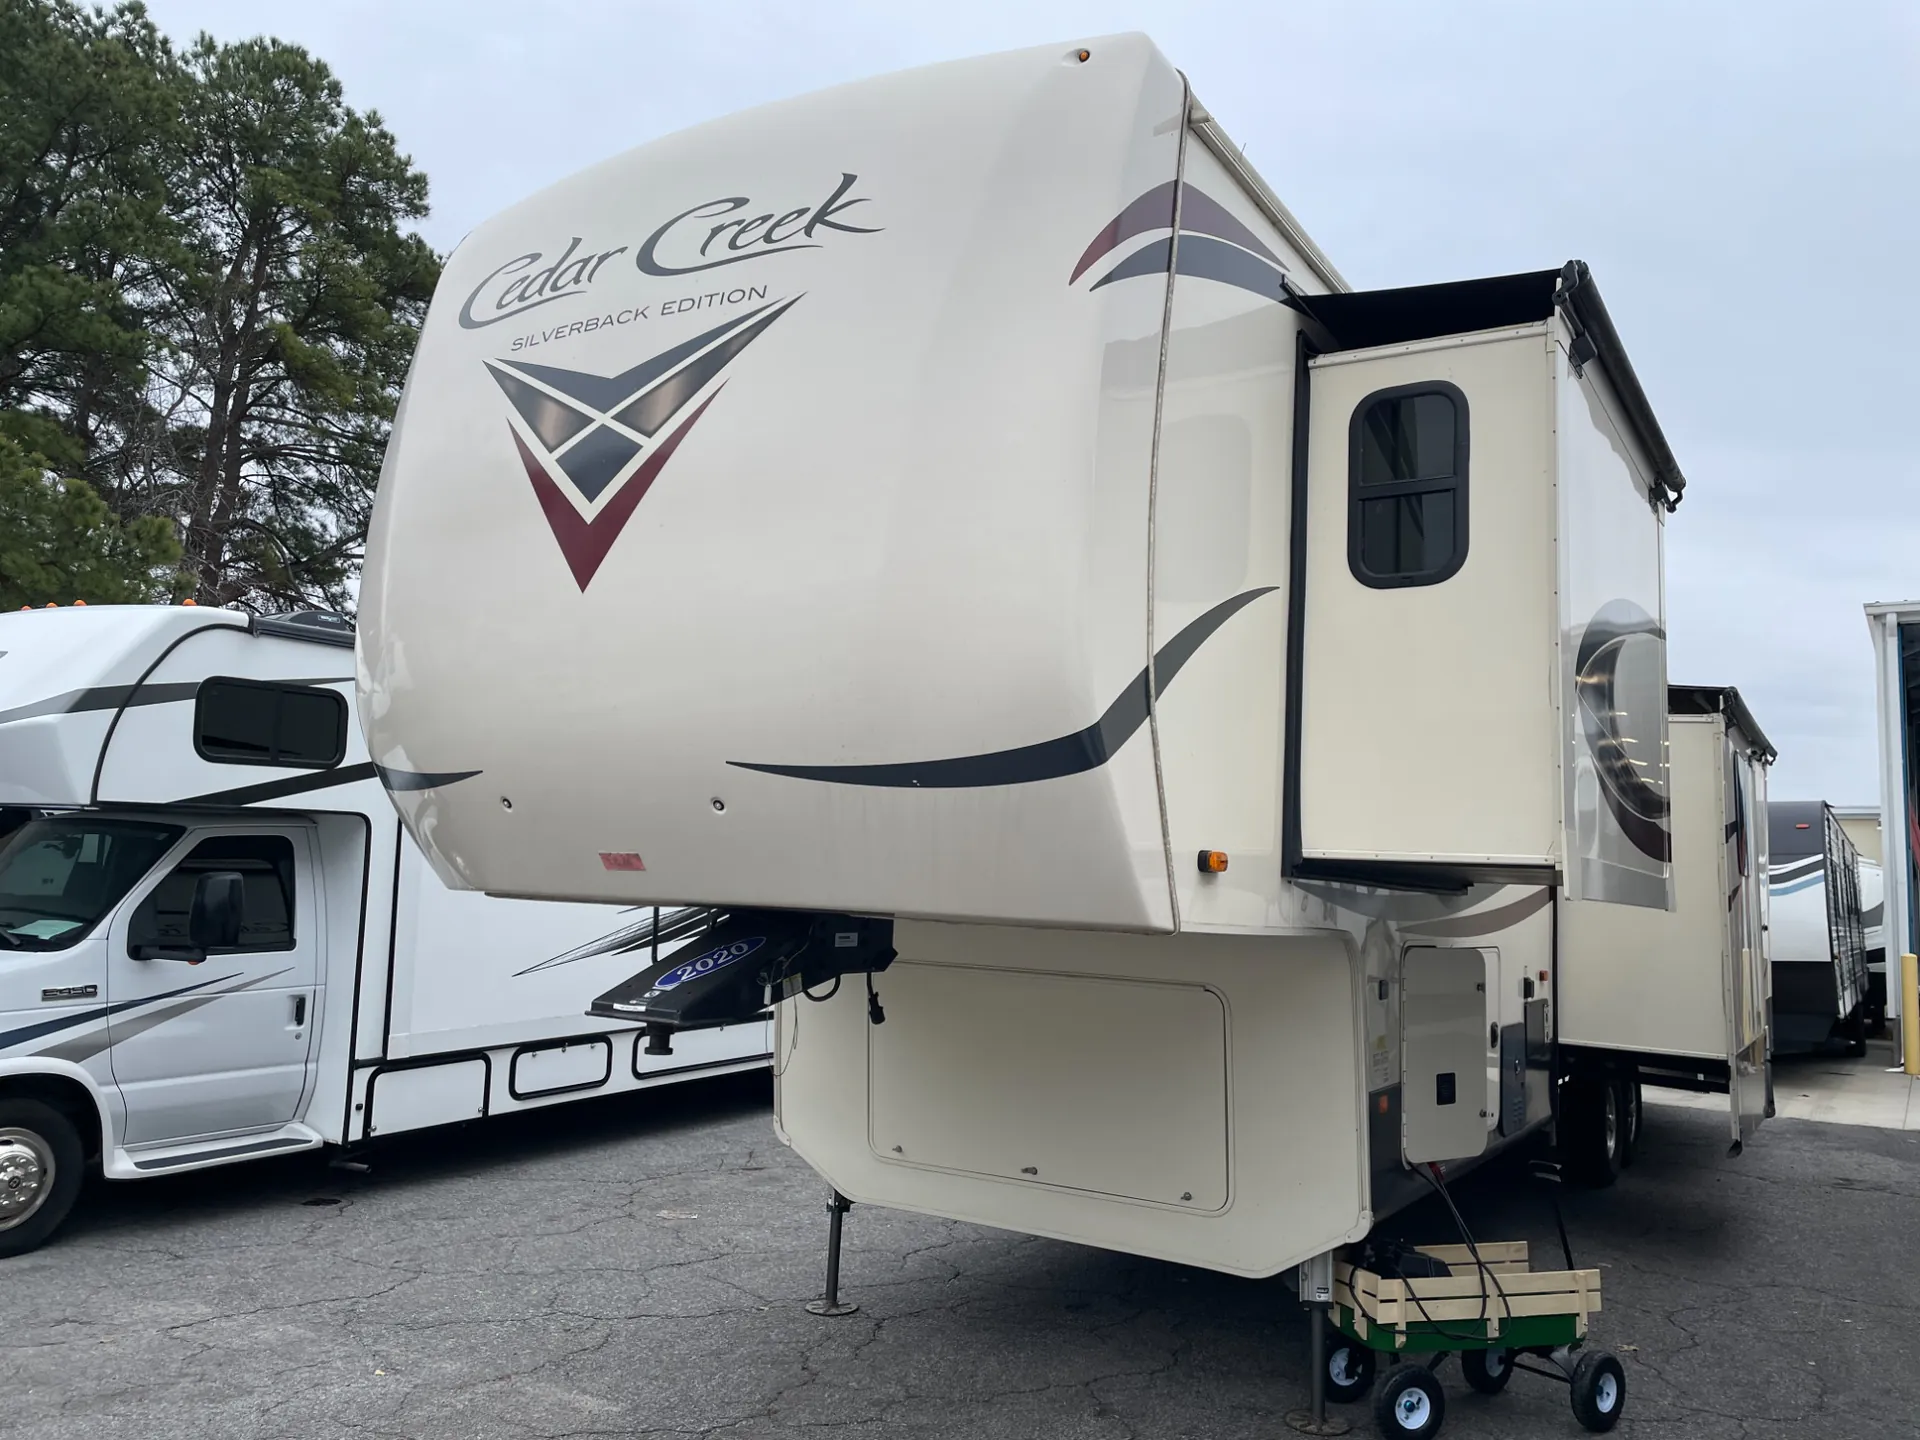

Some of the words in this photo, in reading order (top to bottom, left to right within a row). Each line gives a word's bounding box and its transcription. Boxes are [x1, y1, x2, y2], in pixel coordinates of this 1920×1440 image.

[458, 236, 628, 330] Cedar
[635, 172, 886, 277] Creek
[510, 305, 650, 352] SILVERBACK
[660, 284, 768, 317] EDITION
[677, 943, 749, 982] 2020
